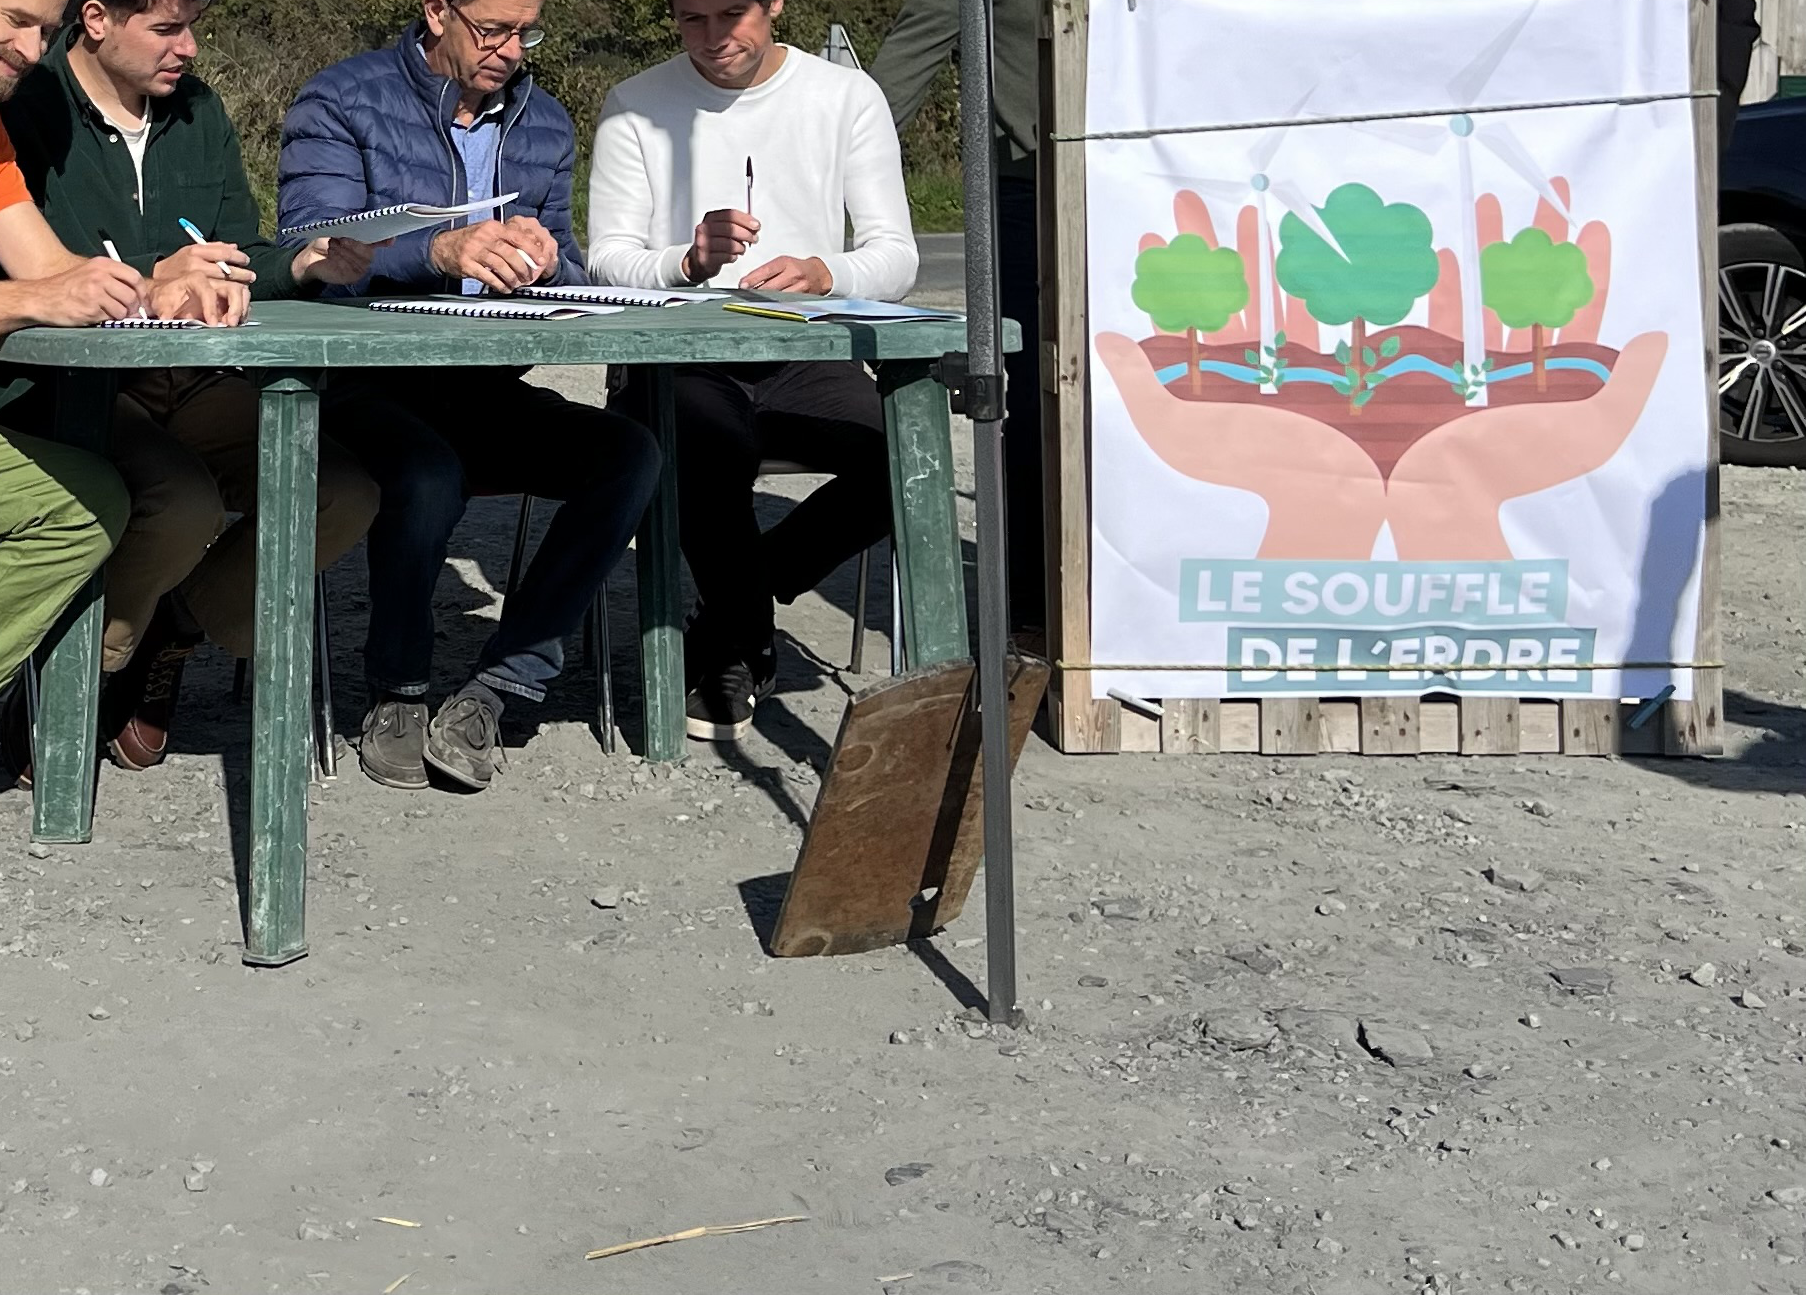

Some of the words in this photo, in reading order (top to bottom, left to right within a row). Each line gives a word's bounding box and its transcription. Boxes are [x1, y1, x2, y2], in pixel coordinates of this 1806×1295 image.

[1196, 570, 1263, 613] LE
[1281, 571, 1552, 616] SOUFFLE
[1240, 637, 1318, 682] DE
